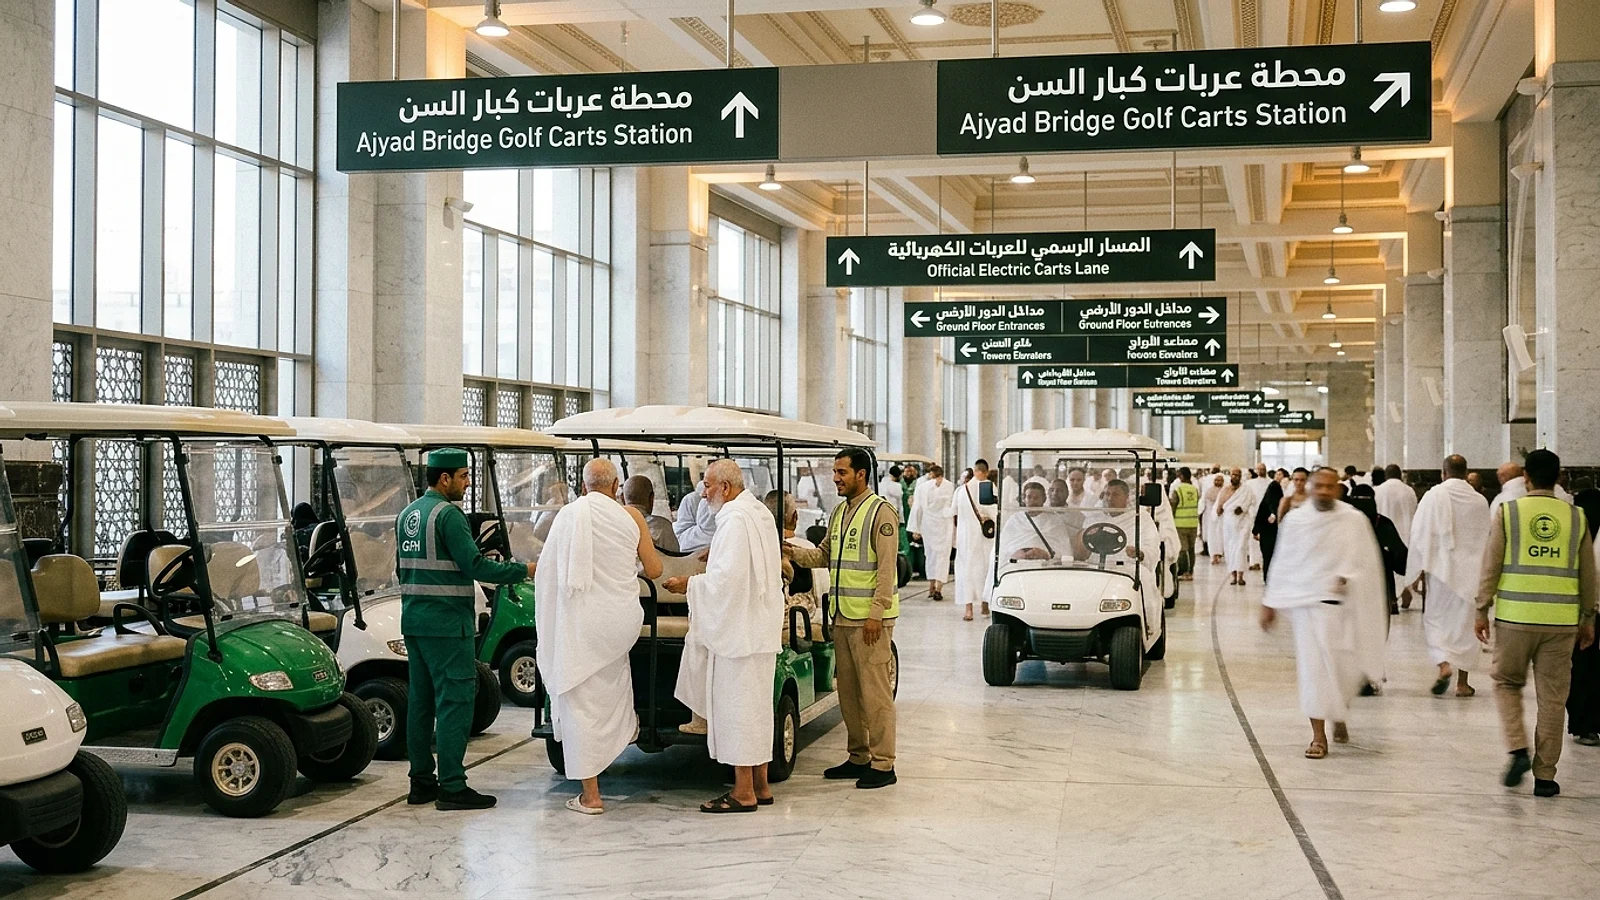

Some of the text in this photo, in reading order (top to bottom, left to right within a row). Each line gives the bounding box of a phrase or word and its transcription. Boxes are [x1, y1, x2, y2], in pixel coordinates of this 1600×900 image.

[1009, 60, 1345, 103] محطة عربات كبار السن
[399, 85, 692, 123] محطة عربات كبار السن
[960, 101, 1346, 139] Ajyad Bridge Golf Carts Station
[357, 123, 691, 157] Ajyad Bridge Golf Carts Station
[888, 237, 1150, 261] المسار الرسمي للعربات الكهربائية
[928, 262, 1109, 277] Official Electric Carts Lane
[972, 321, 996, 330] Floor
[999, 321, 1045, 330] Entrances
[1528, 545, 1560, 558] GPH
